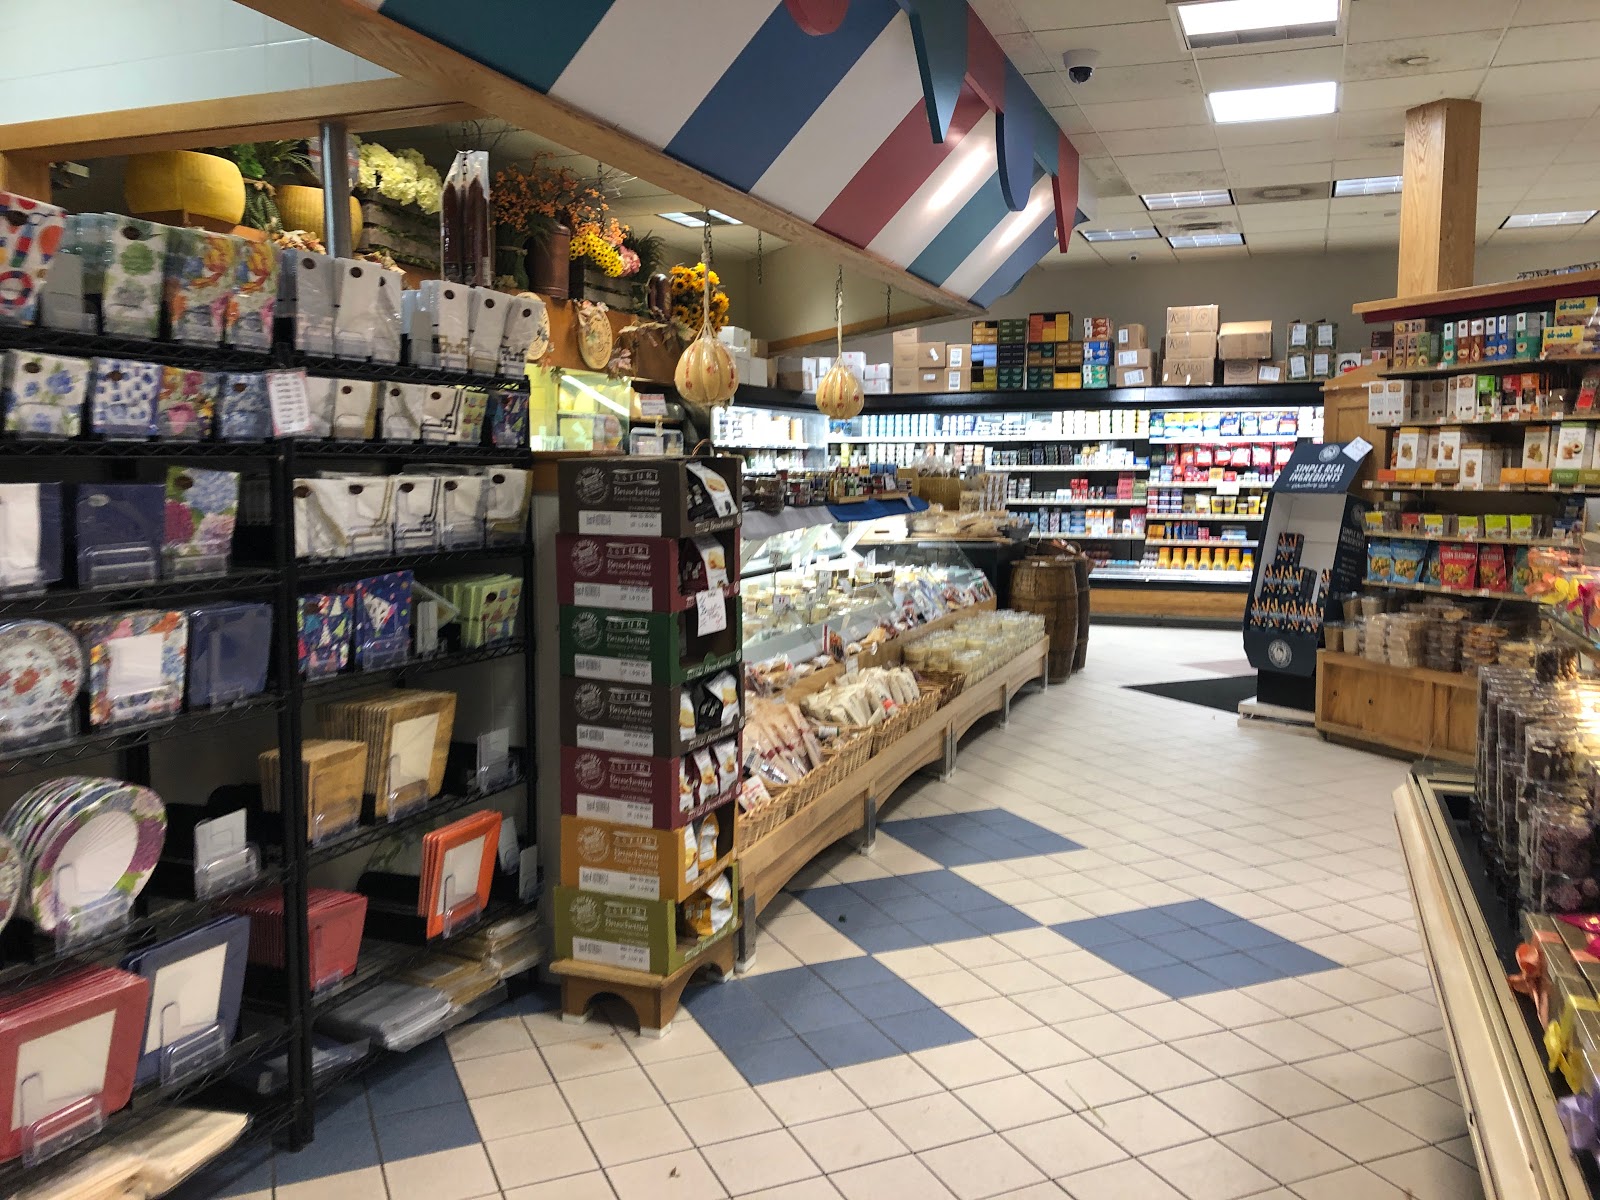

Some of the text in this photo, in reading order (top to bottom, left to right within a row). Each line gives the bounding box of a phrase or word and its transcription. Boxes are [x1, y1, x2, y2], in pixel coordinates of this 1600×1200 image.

[1294, 463, 1346, 474] SIMPLE REAL
[1288, 472, 1343, 483] INGREDIENTS
